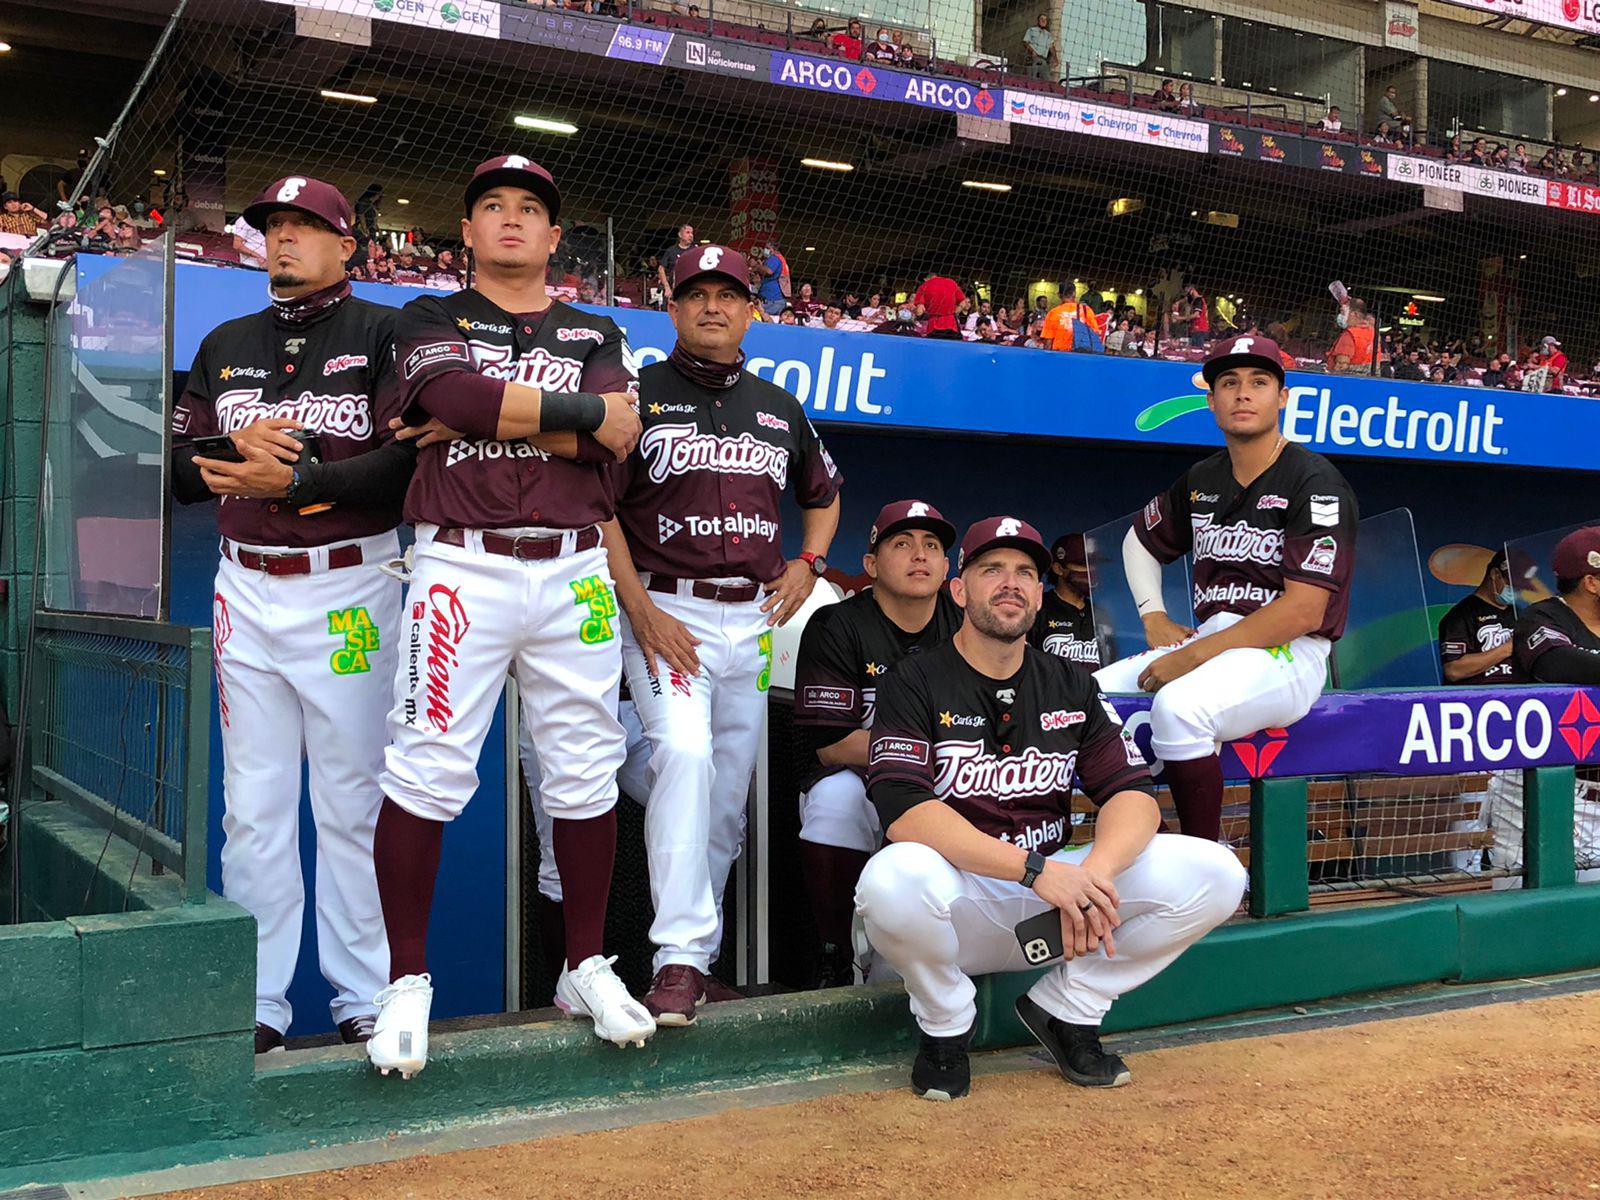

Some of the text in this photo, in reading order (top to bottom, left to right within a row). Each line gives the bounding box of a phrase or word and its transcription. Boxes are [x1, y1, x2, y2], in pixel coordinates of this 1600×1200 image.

[462, 11, 489, 24] GEN
[618, 36, 663, 53] 96.9 FM
[780, 59, 852, 91] ARCO
[905, 78, 971, 110] ARCO
[1028, 104, 1070, 121] Chevron
[1097, 115, 1138, 132] Chevron
[1163, 127, 1202, 143] Chevron
[1418, 163, 1461, 183] PIONEER
[1498, 178, 1539, 197] PIONEER
[194, 200, 224, 210] debate
[425, 345, 451, 356] ARCO
[324, 355, 368, 375] SuKarne
[215, 388, 374, 441] Tomateros
[1285, 386, 1503, 455] Electrolit
[640, 422, 789, 490] Tomateros
[685, 512, 777, 542] Totalplay
[1205, 582, 1277, 607] otalplay
[1043, 633, 1100, 662] Tomat
[426, 583, 471, 733] Caliente
[820, 691, 840, 699] ARCO
[1041, 710, 1086, 731] SuKarne
[1399, 698, 1552, 764] ARCO
[889, 742, 913, 752] ARCO
[934, 739, 1078, 801] Tomatero
